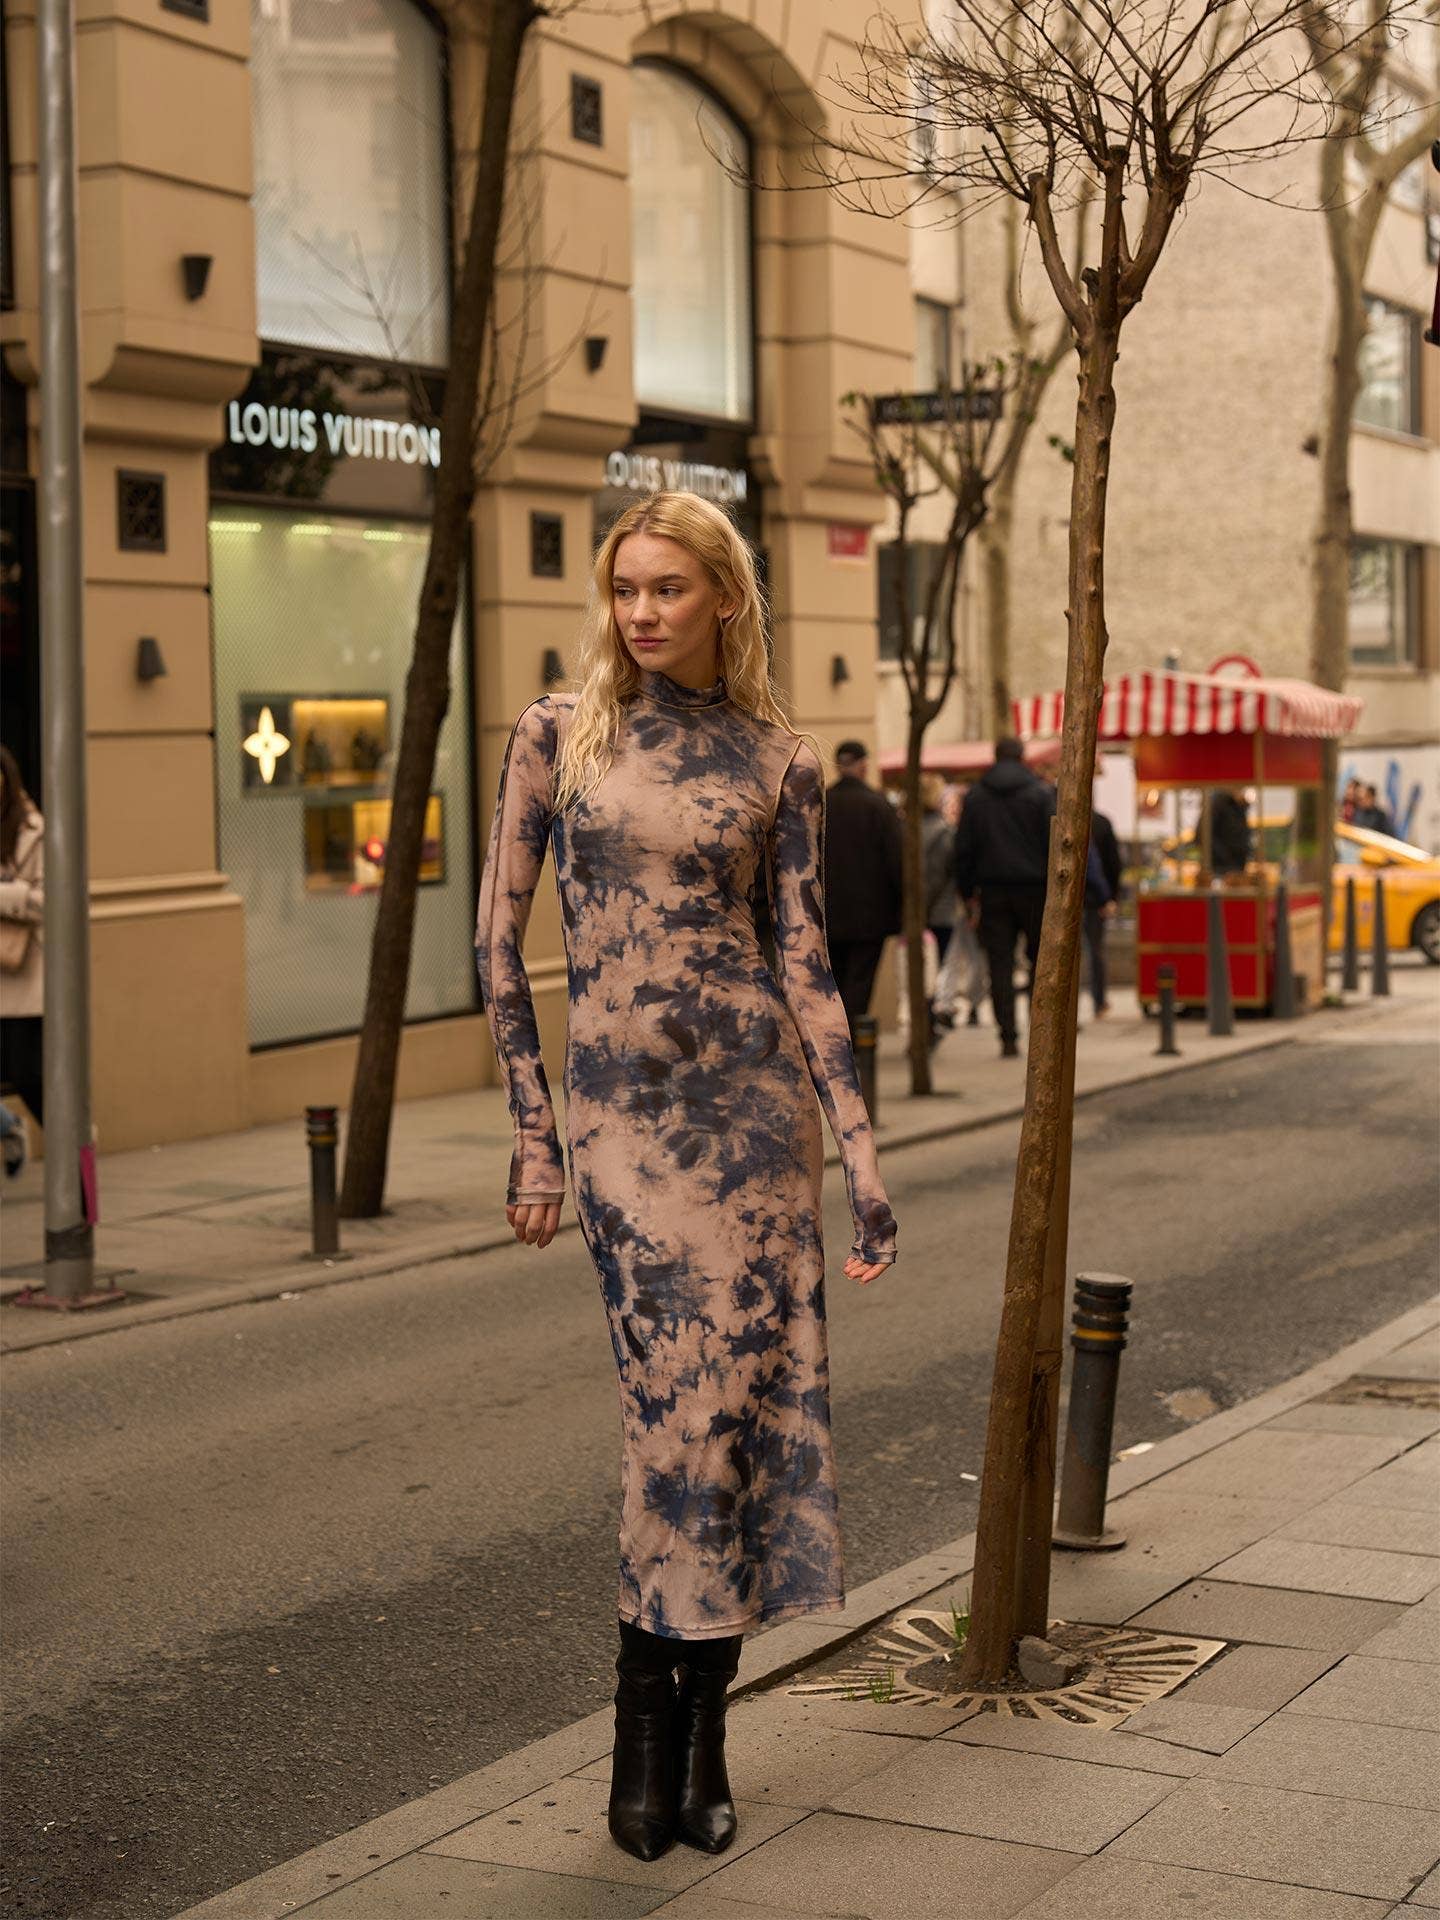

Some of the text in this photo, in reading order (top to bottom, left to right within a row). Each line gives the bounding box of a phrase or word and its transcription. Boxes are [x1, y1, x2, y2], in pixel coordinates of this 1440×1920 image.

[229, 400, 441, 468] LOUIS VUITTON
[602, 451, 747, 502] OUIS VUITTON
